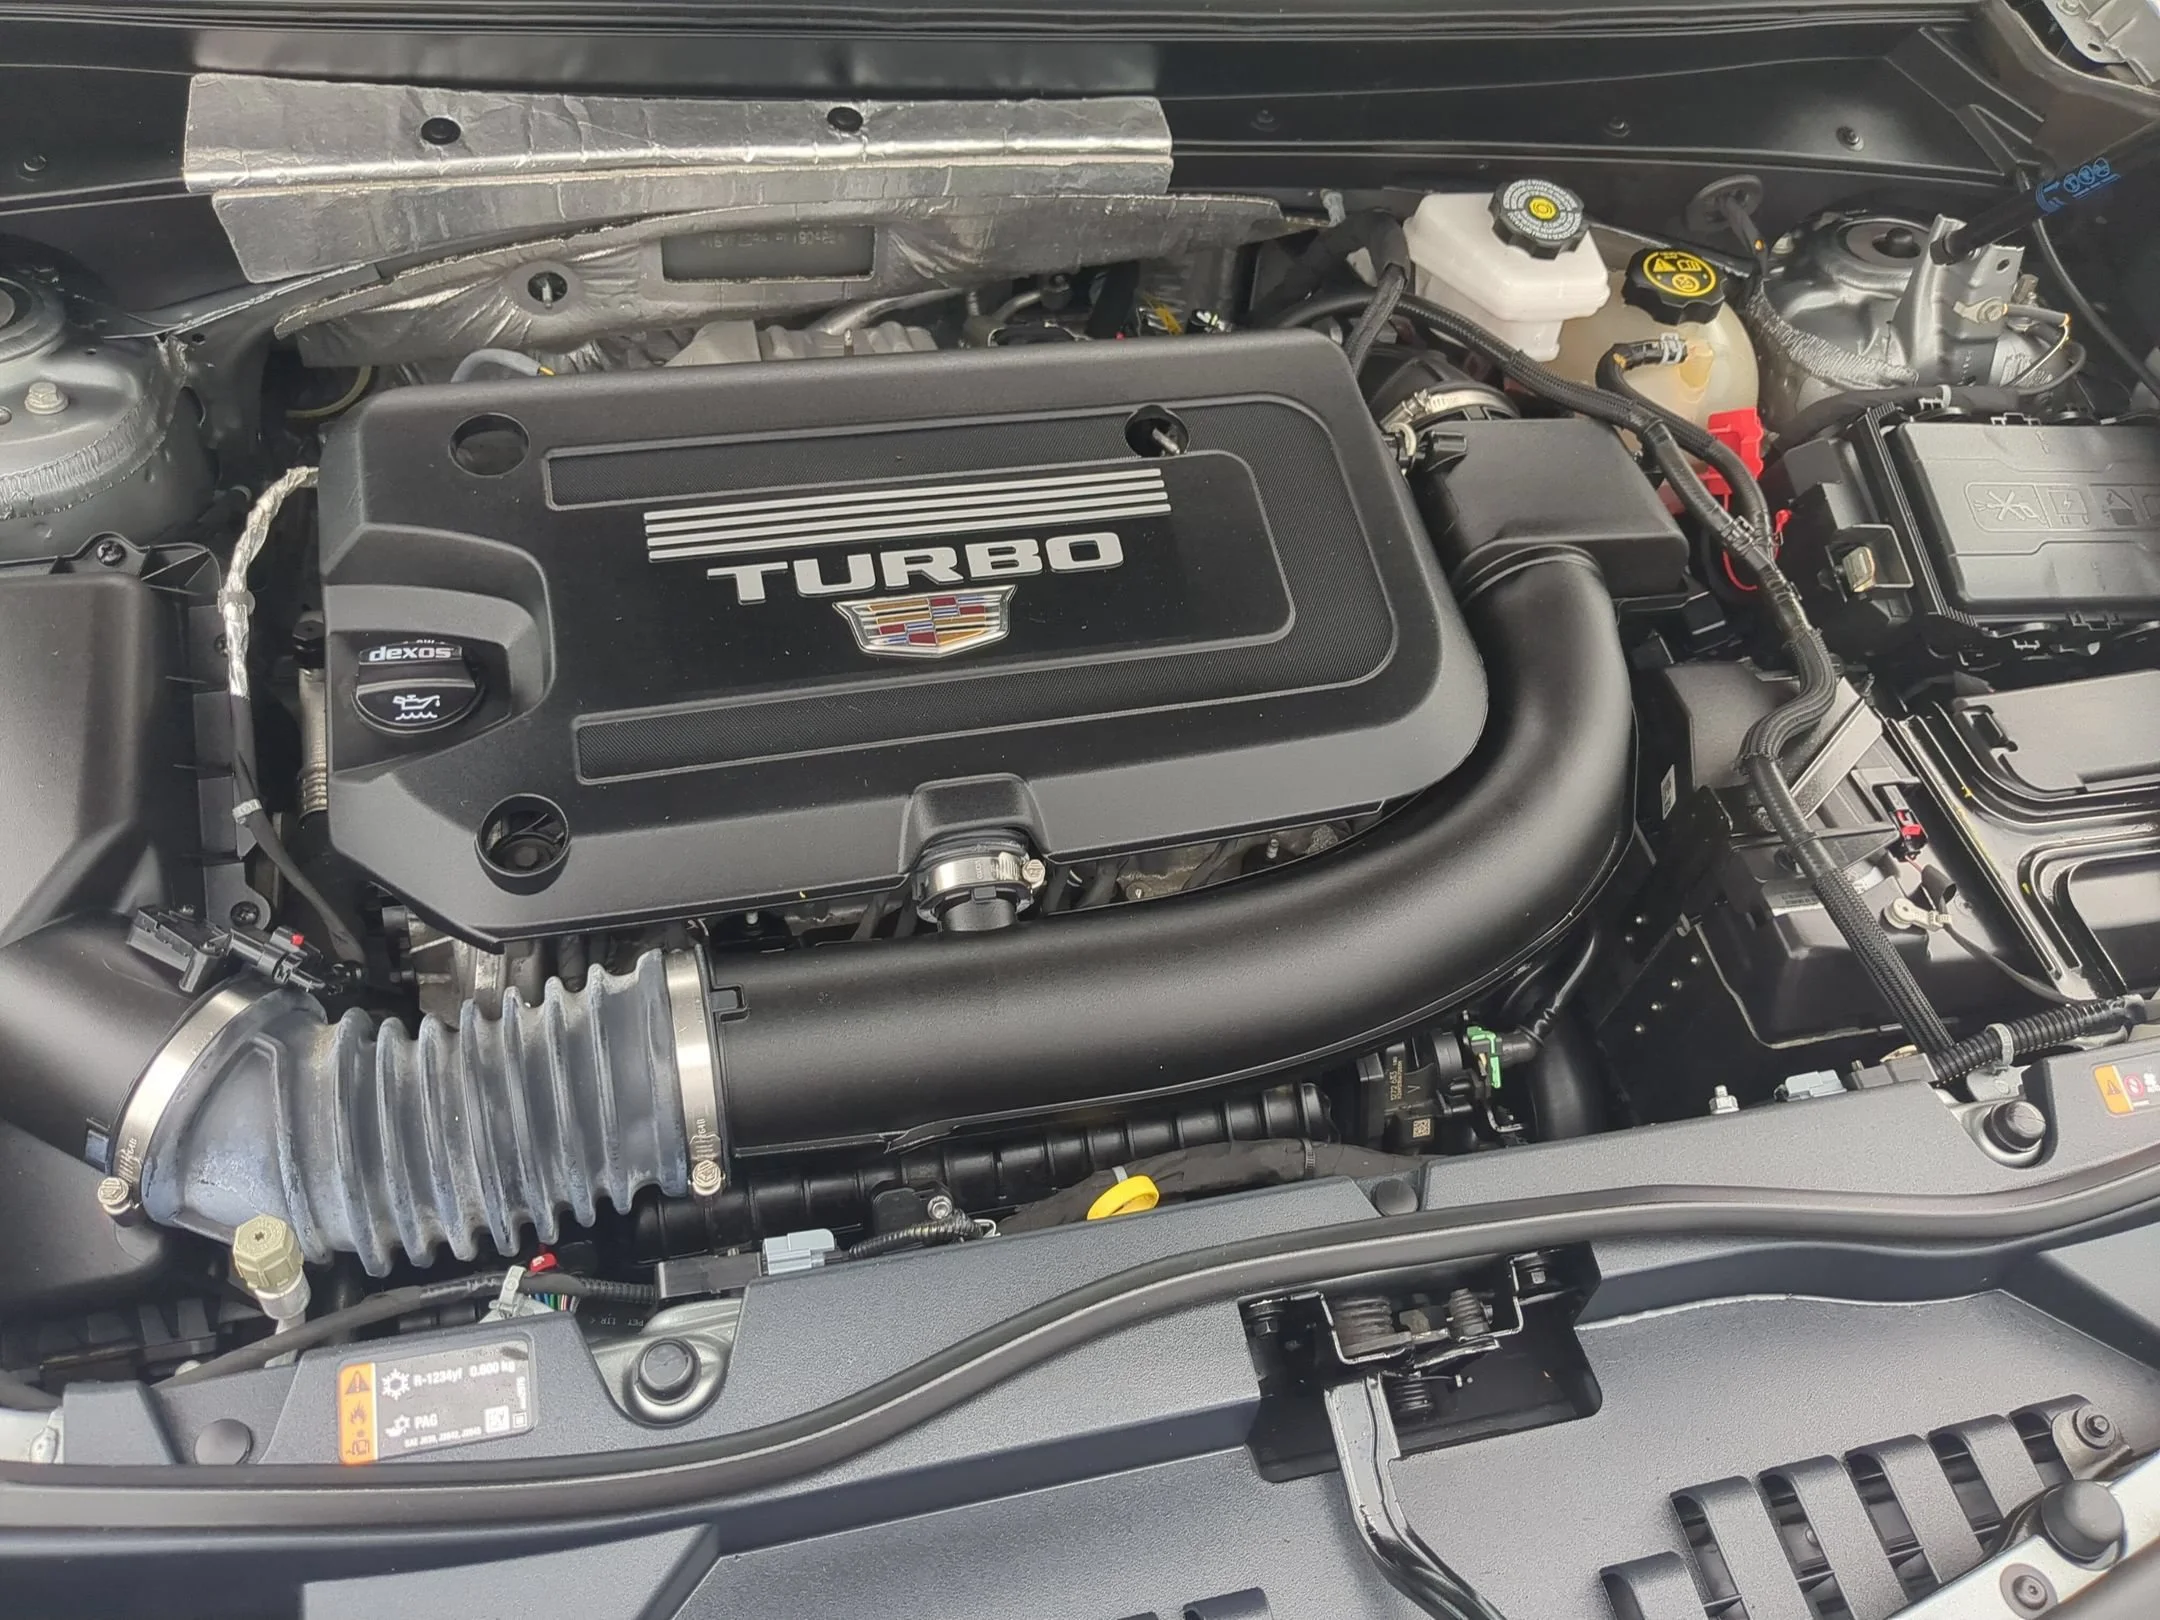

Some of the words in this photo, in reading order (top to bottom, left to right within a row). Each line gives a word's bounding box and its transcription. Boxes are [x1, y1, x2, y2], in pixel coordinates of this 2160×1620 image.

[707, 532, 1125, 606] TURBO
[368, 646, 454, 661] dexos
[413, 1367, 463, 1387] R-1234yf
[501, 1359, 516, 1373] kg
[414, 1413, 438, 1430] PAG
